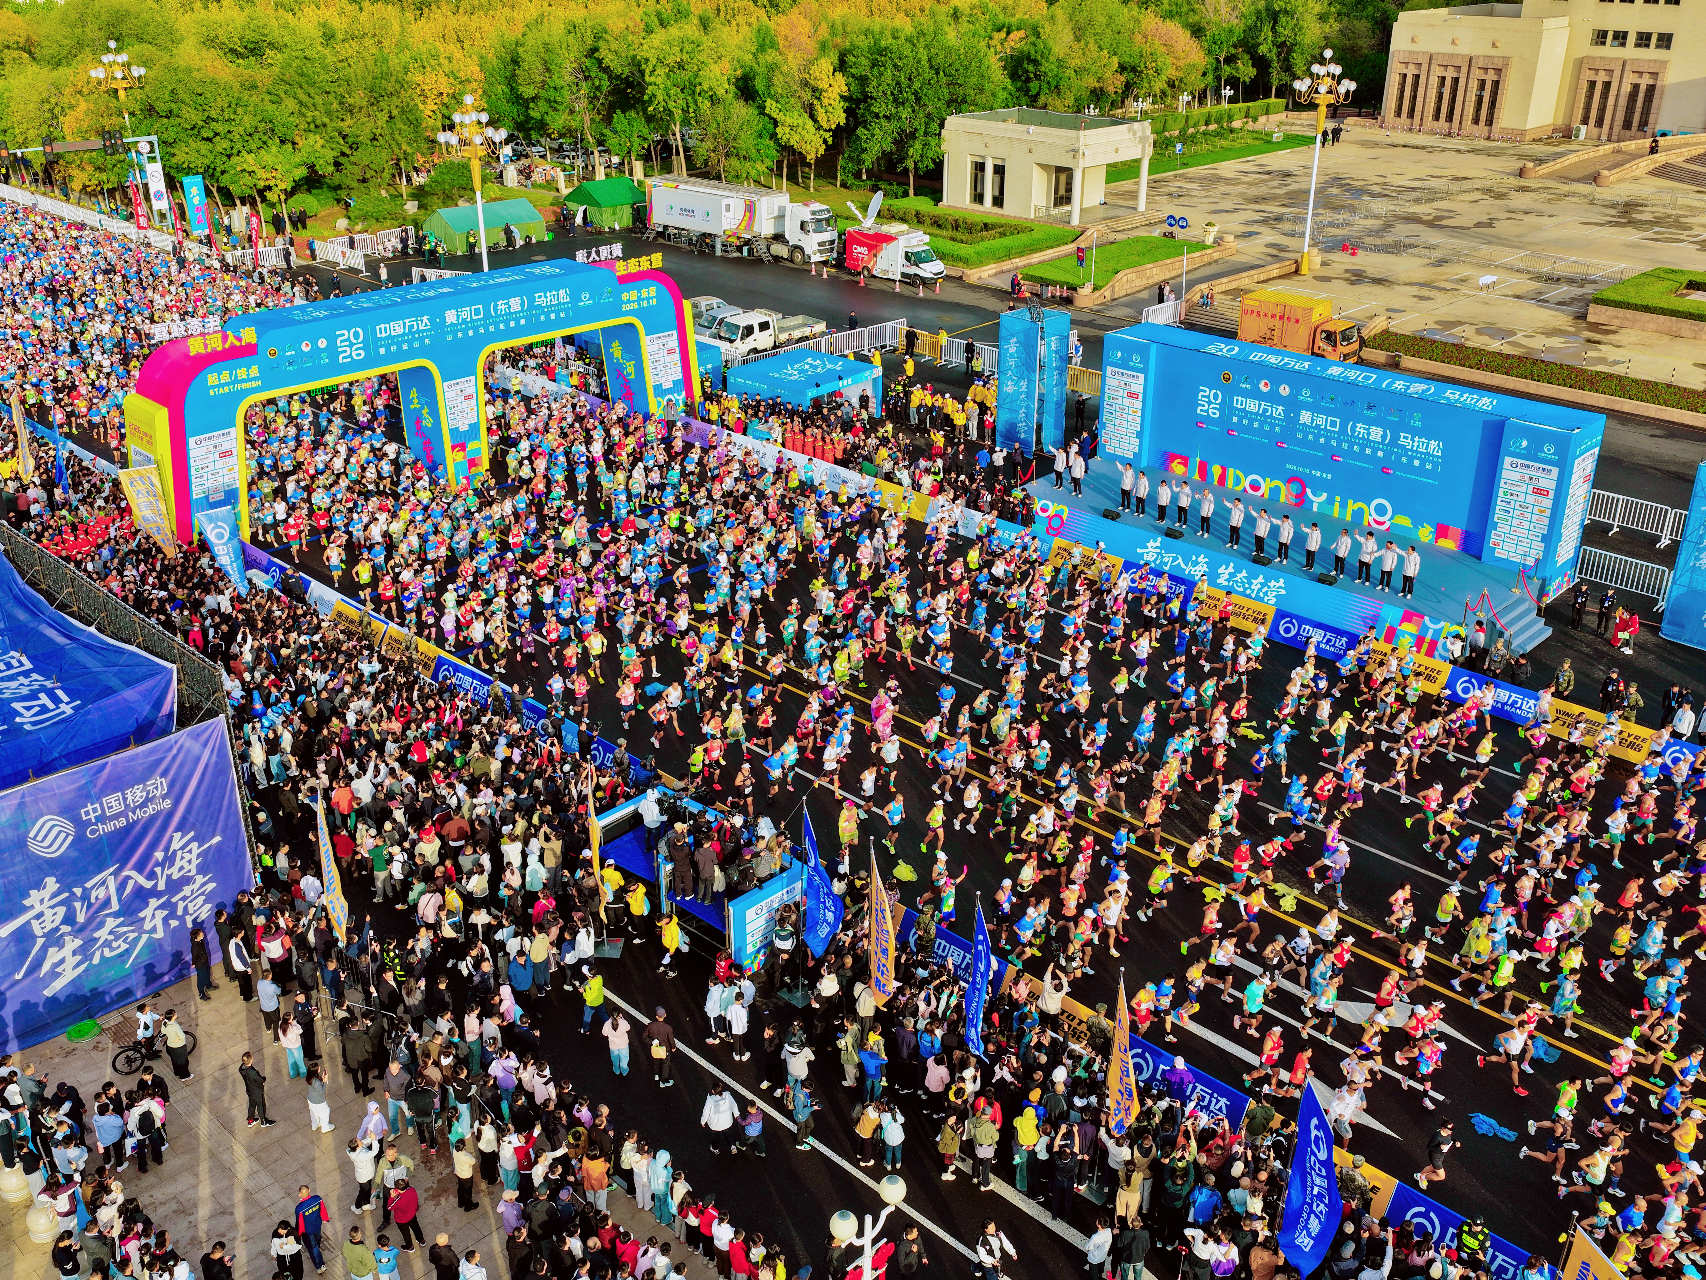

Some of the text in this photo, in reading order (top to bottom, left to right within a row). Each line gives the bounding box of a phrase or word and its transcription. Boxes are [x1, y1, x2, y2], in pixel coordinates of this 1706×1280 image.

[852, 245, 869, 255] CMG
[615, 252, 663, 276] 生态东营
[621, 287, 657, 301] 中国·东营
[621, 299, 657, 311] 2026.10.18
[376, 287, 570, 338] 中国万达·黄河口（东营）马拉松
[187, 327, 258, 356] 黄河入海
[336, 327, 364, 347] 20
[337, 343, 365, 363] 26
[207, 365, 260, 386] 起点/终点
[209, 380, 262, 396] START/FINISH
[1198, 386, 1222, 404] 20
[1197, 400, 1220, 418] 26
[1233, 396, 1443, 457] 中国万达·黄河口（东营）马拉松
[1137, 537, 1209, 580] 黄河入海
[1217, 562, 1287, 605] 生态东营
[1300, 624, 1349, 650] 中国万达
[1319, 643, 1345, 656] WANDA
[1485, 686, 1538, 713] 国万达
[1504, 704, 1533, 719] WANDA
[80, 776, 168, 824] 中国移动
[86, 798, 172, 839] China Mobile
[0, 830, 222, 940] 黄河入海
[816, 904, 825, 930] GROUP
[15, 875, 218, 998] 生态东营
[1295, 1205, 1310, 1238] GROUP
